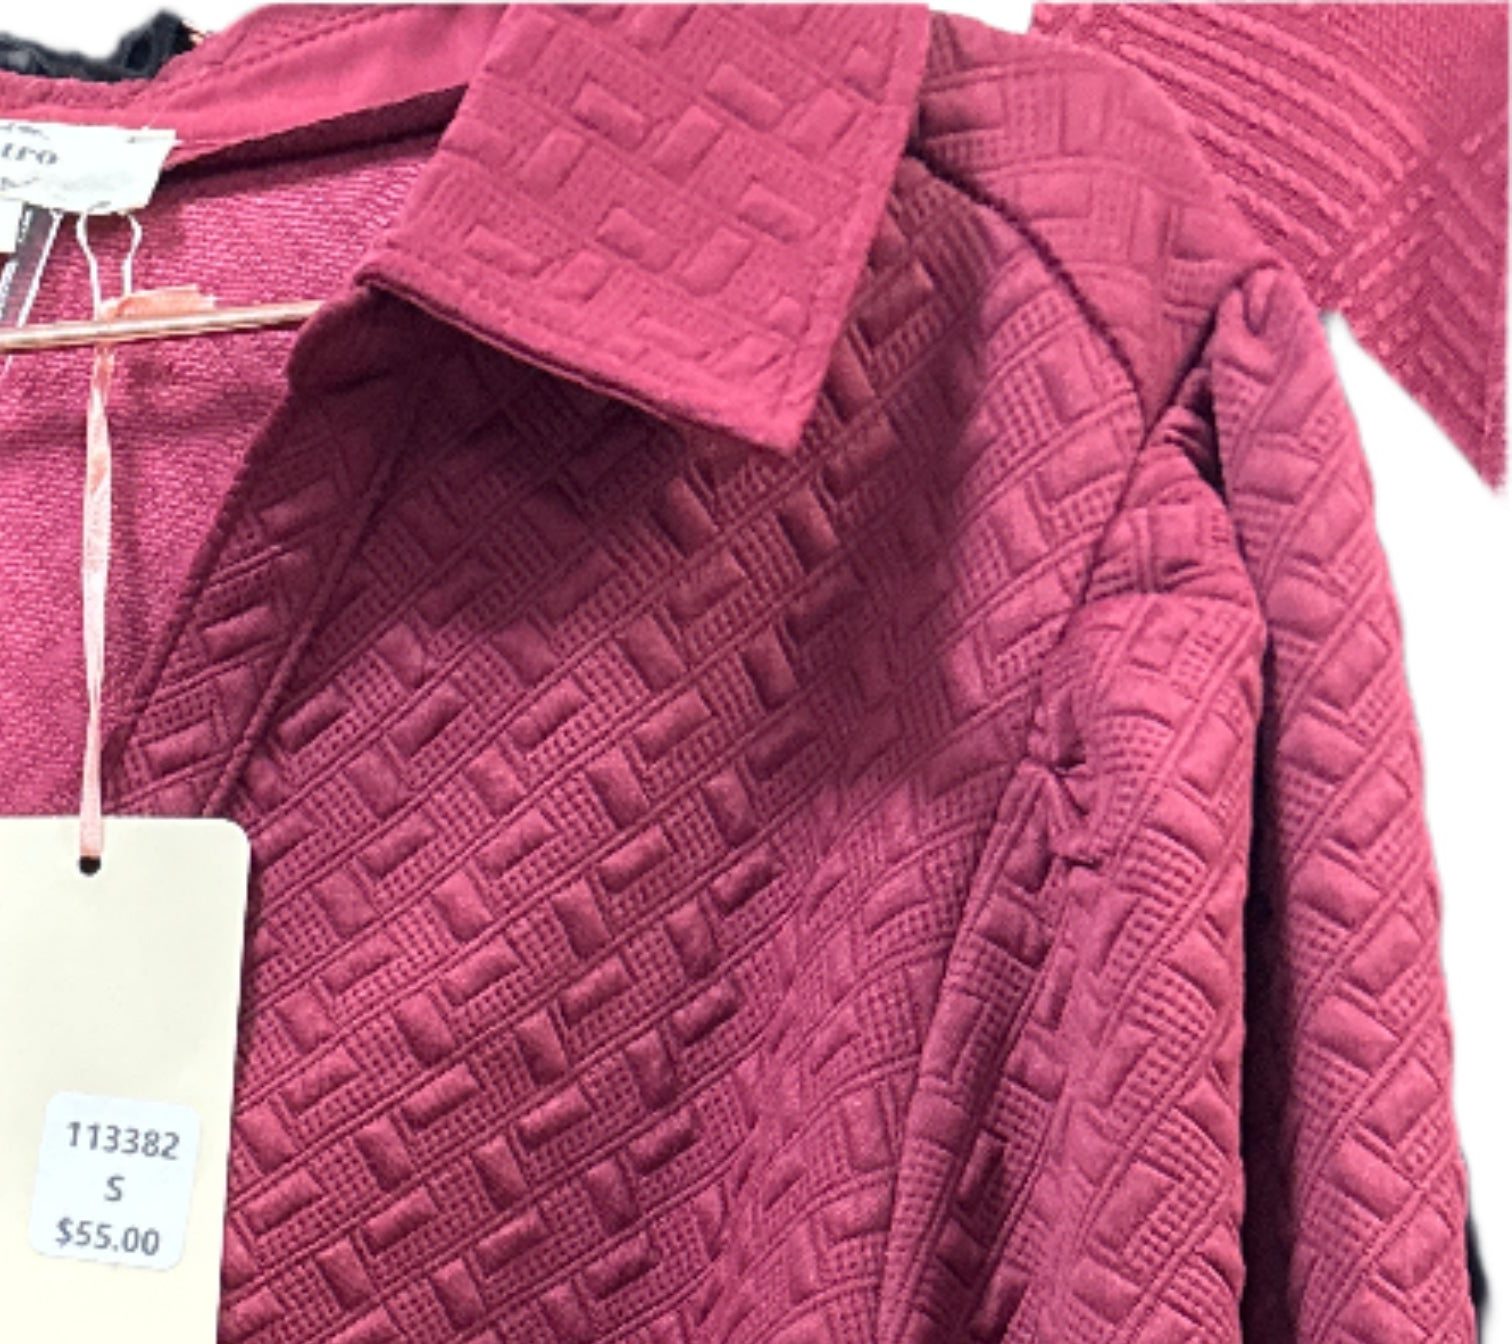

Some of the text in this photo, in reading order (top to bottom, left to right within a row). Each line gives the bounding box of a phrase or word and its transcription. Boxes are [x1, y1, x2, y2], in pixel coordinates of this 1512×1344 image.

[67, 1120, 180, 1160] 113382
[103, 1174, 125, 1202] S
[55, 1216, 160, 1256] $55.00
